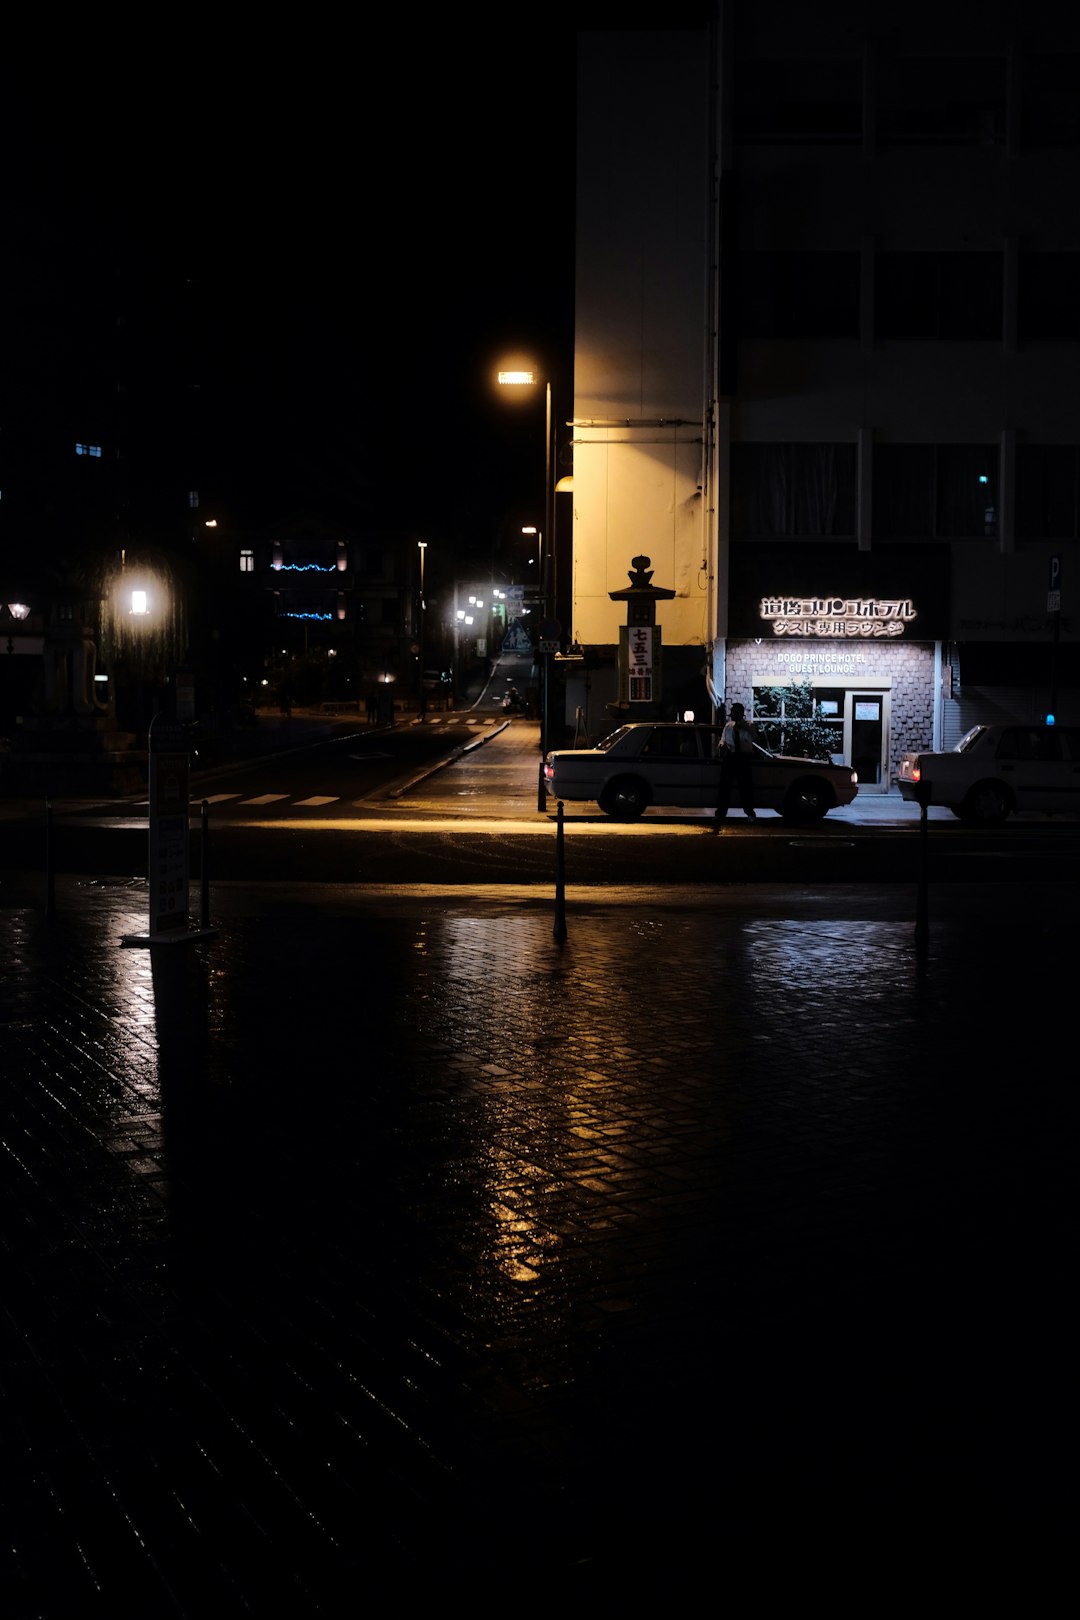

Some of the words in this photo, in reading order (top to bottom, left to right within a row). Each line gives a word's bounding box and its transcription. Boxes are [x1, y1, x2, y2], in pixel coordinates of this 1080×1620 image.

[1051, 557, 1060, 588] P
[762, 598, 916, 619] 道後プリンスホテル
[774, 620, 904, 636] ゲスト専用ラウンジ
[633, 629, 648, 666] 七五三
[778, 653, 803, 664] DOGO
[804, 653, 837, 664] PRINCE
[839, 653, 867, 664] HOTEL
[789, 664, 818, 674] GUEST
[819, 664, 856, 674] LOUNGE
